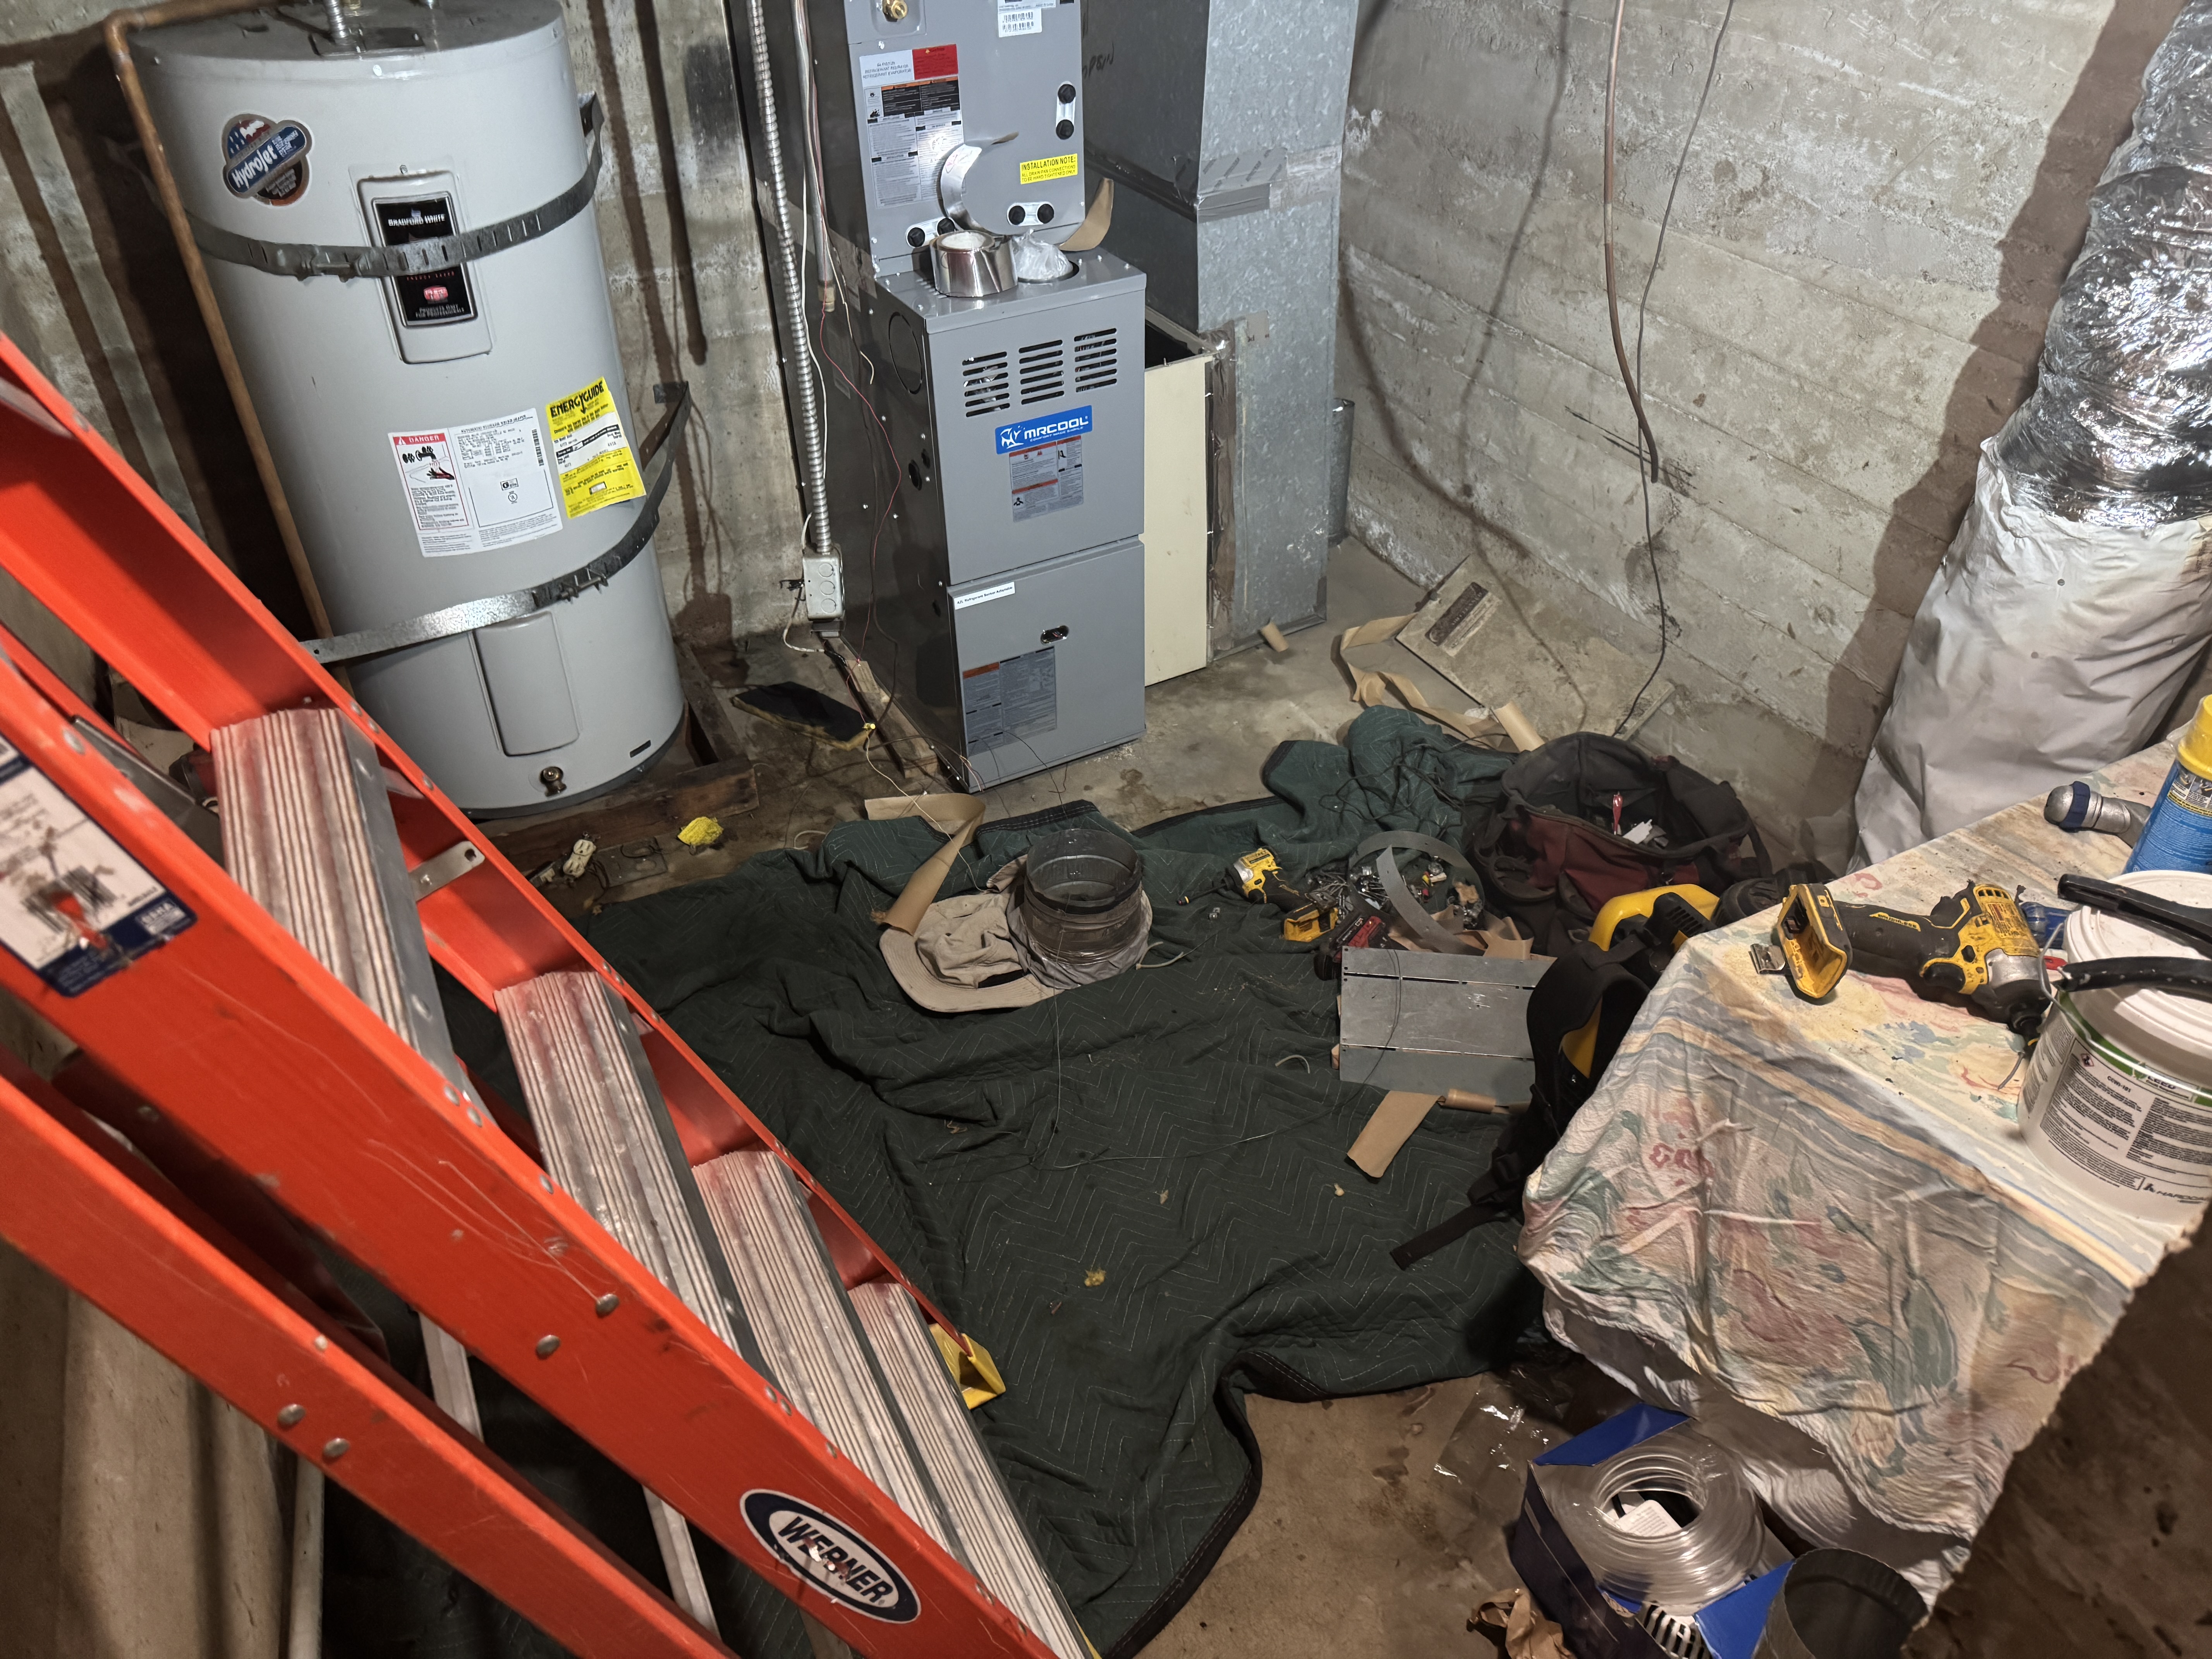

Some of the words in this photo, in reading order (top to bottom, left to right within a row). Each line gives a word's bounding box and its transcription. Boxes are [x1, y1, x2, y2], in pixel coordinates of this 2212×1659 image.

[232, 144, 278, 189] HydroJet
[1022, 158, 1059, 172] INSTALLATION
[1060, 156, 1075, 164] NOTE:
[388, 216, 424, 227] BRADFORD
[424, 214, 446, 224] WHITE
[550, 380, 604, 418] ENERGYGUIDE
[1024, 417, 1089, 440] MRCOOL
[1878, 914, 1917, 928] BRUSHLESS
[778, 1516, 894, 1604] WERNER
